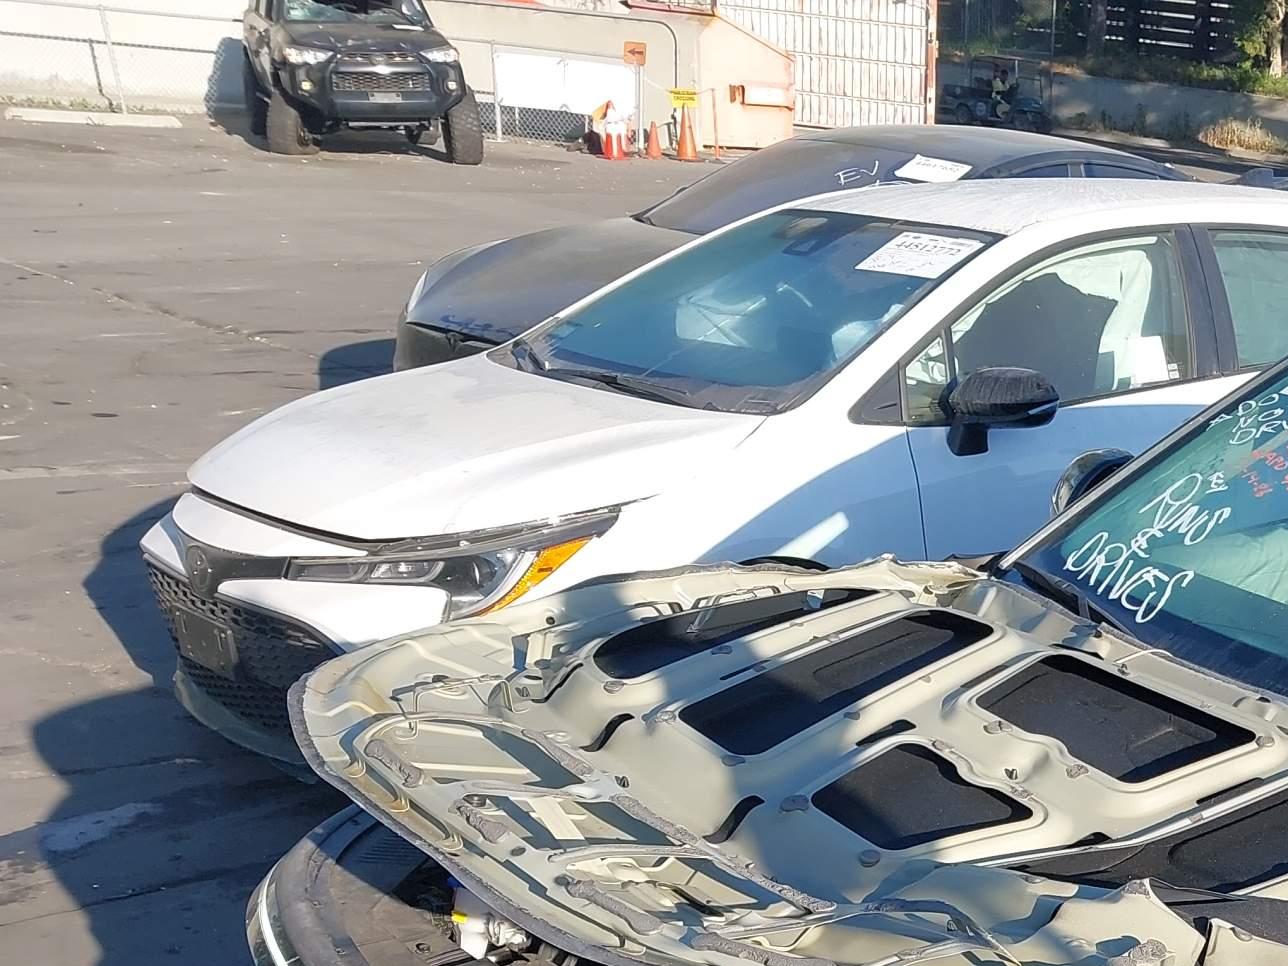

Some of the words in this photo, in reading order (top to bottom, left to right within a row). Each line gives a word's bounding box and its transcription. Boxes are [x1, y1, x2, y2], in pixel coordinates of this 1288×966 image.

[834, 160, 879, 186] EV
[1139, 473, 1231, 546] RUNS
[1063, 531, 1195, 624] DRIVES
